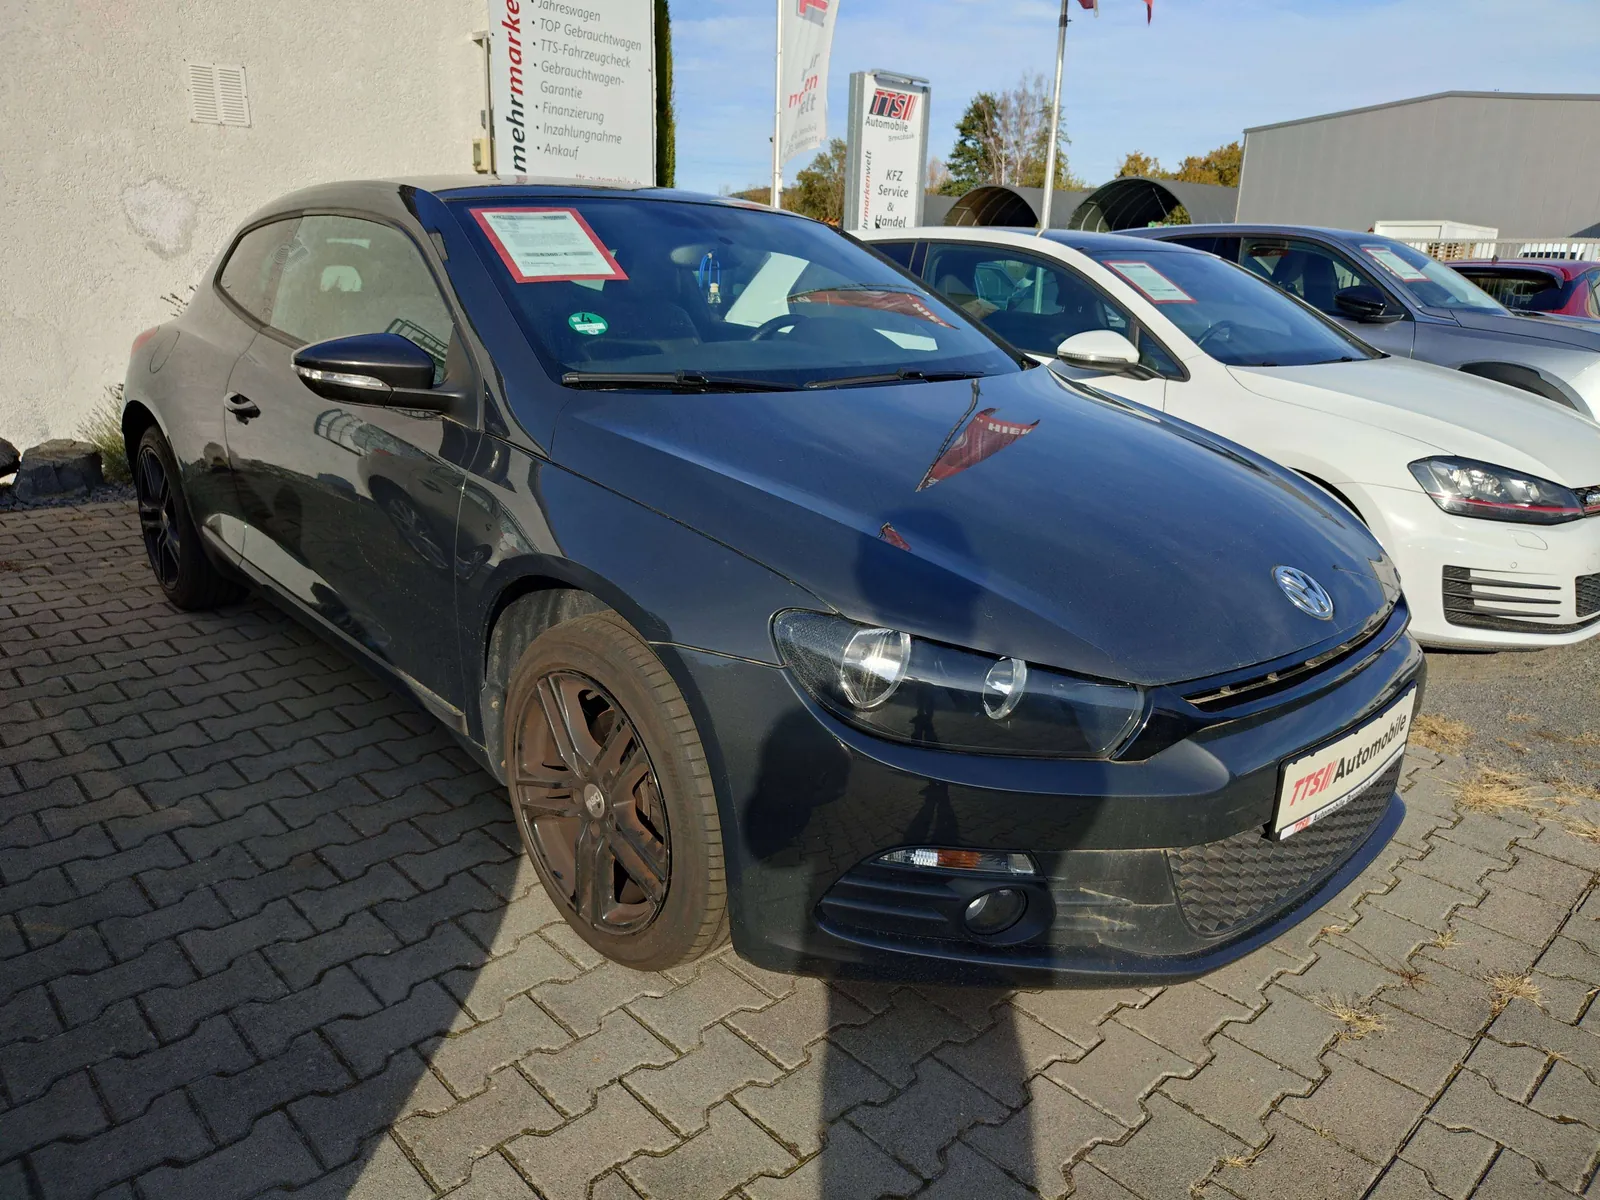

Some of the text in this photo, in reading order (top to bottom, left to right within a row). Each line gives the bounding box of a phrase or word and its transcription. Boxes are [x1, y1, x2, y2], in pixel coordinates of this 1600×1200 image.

[540, 18, 642, 52] TOP Gebrauchtwagen
[541, 39, 631, 68] TTS-Fahrzeugcheck
[541, 60, 625, 87] Gebrauchtwagen-
[540, 80, 583, 99] Garantie
[542, 102, 605, 126] Finanzierung
[543, 122, 622, 145] Inzahlungnahme
[865, 116, 909, 132] Automobile
[543, 143, 580, 160] Ankauf
[886, 169, 903, 182] KFZ
[878, 184, 909, 198] Service
[887, 202, 895, 212] &
[875, 215, 907, 229] Handel
[1333, 714, 1407, 784] Automobile
